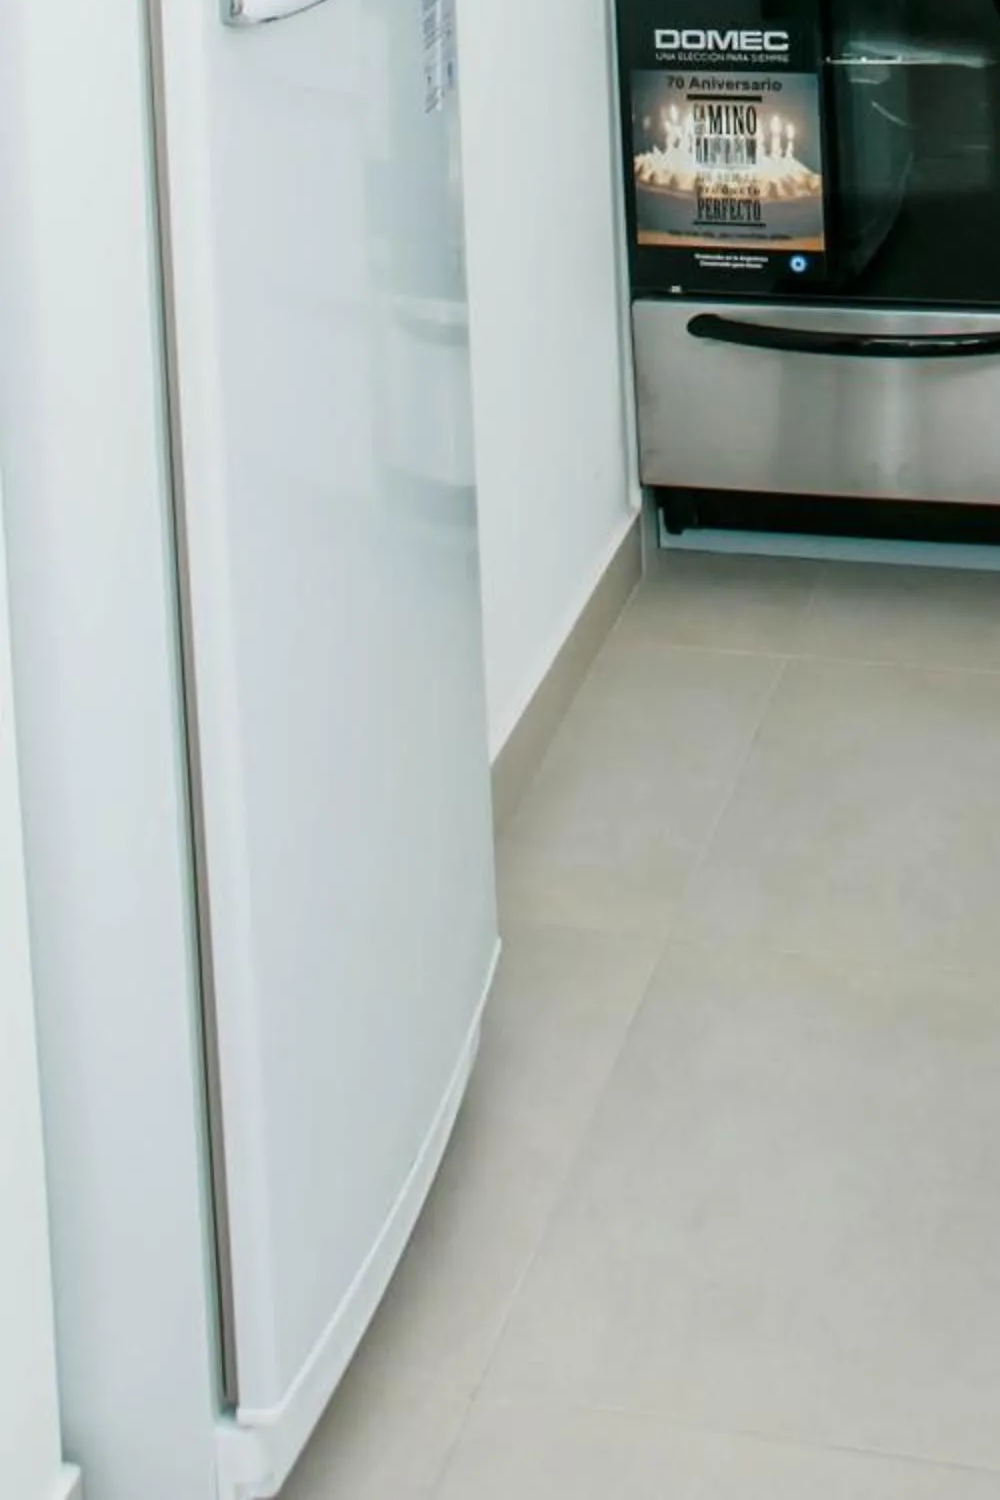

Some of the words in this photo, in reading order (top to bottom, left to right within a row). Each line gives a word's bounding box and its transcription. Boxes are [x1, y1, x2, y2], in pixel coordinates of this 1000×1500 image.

[654, 29, 789, 51] DOMEC
[667, 75, 685, 89] 70
[689, 77, 783, 92] Aniversario
[697, 198, 762, 221] PERFECTO
